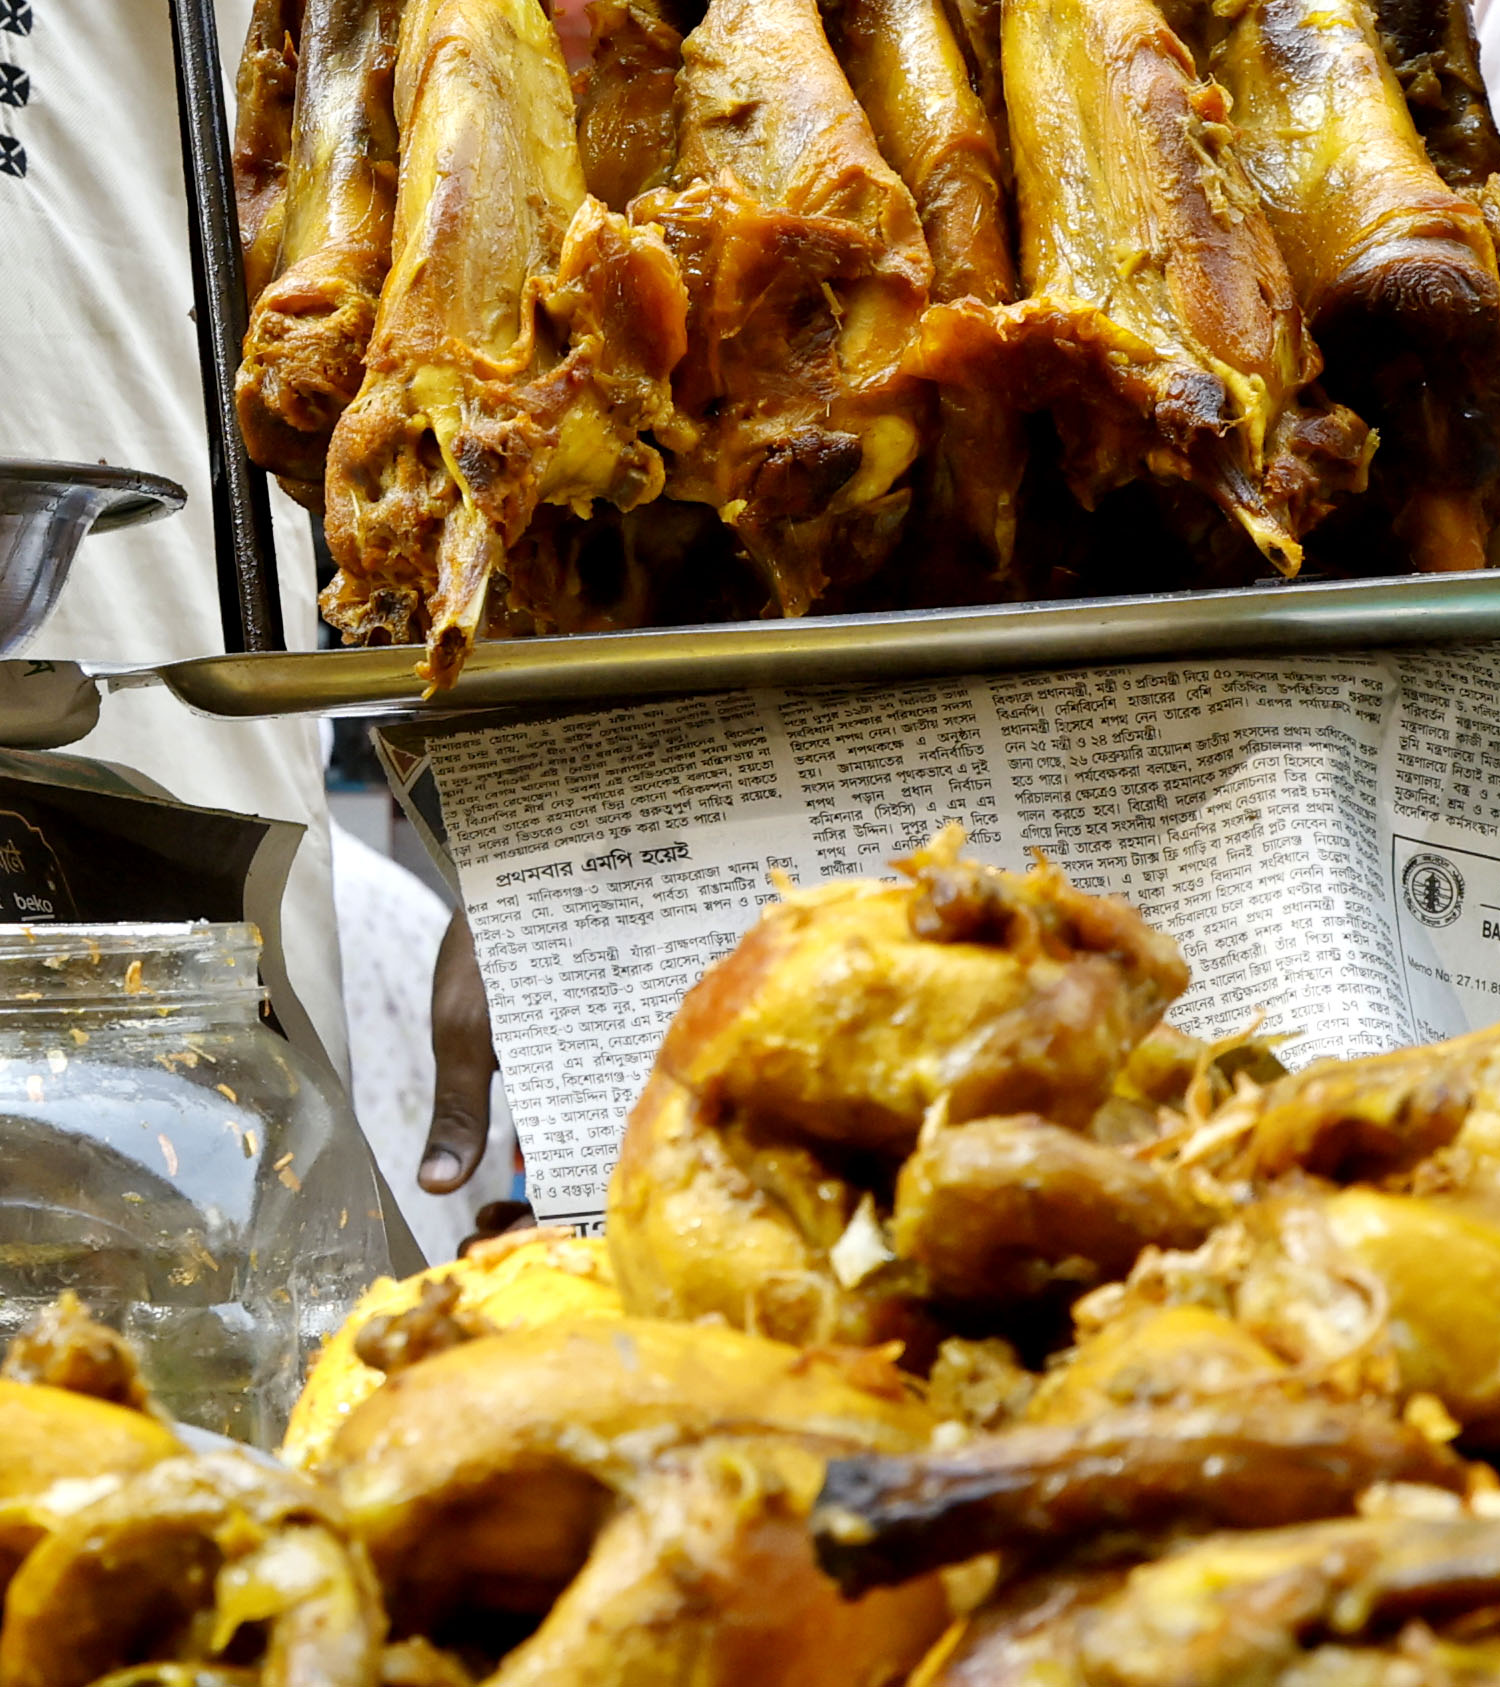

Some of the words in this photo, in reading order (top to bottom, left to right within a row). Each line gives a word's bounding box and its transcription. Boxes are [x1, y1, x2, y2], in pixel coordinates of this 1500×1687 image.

[838, 755, 904, 775] জামায়াতের
[919, 742, 986, 763] নবনির্বাচিত
[901, 784, 934, 799] প্রধান
[949, 777, 993, 795] নির্বাচন
[808, 808, 864, 827] কমিশনার
[812, 827, 847, 844] নাসির
[496, 860, 573, 888] প্রথমবার
[581, 849, 634, 874] এমপি
[638, 841, 694, 866] হয়েই
[526, 882, 600, 907] মানিকগঞ্জ-৩
[606, 875, 654, 893] আসনের
[661, 865, 721, 885] আফরোজা
[728, 859, 760, 874] খানম
[13, 892, 54, 914] beko
[474, 909, 522, 928] আসনের
[575, 912, 611, 931] ফকির
[615, 907, 655, 928] মাহবুব
[487, 940, 528, 958] রবিউল
[558, 966, 607, 985] আসনের
[612, 961, 654, 979] ইশরাক
[495, 1023, 574, 1044] ময়মনসিংহ-৩
